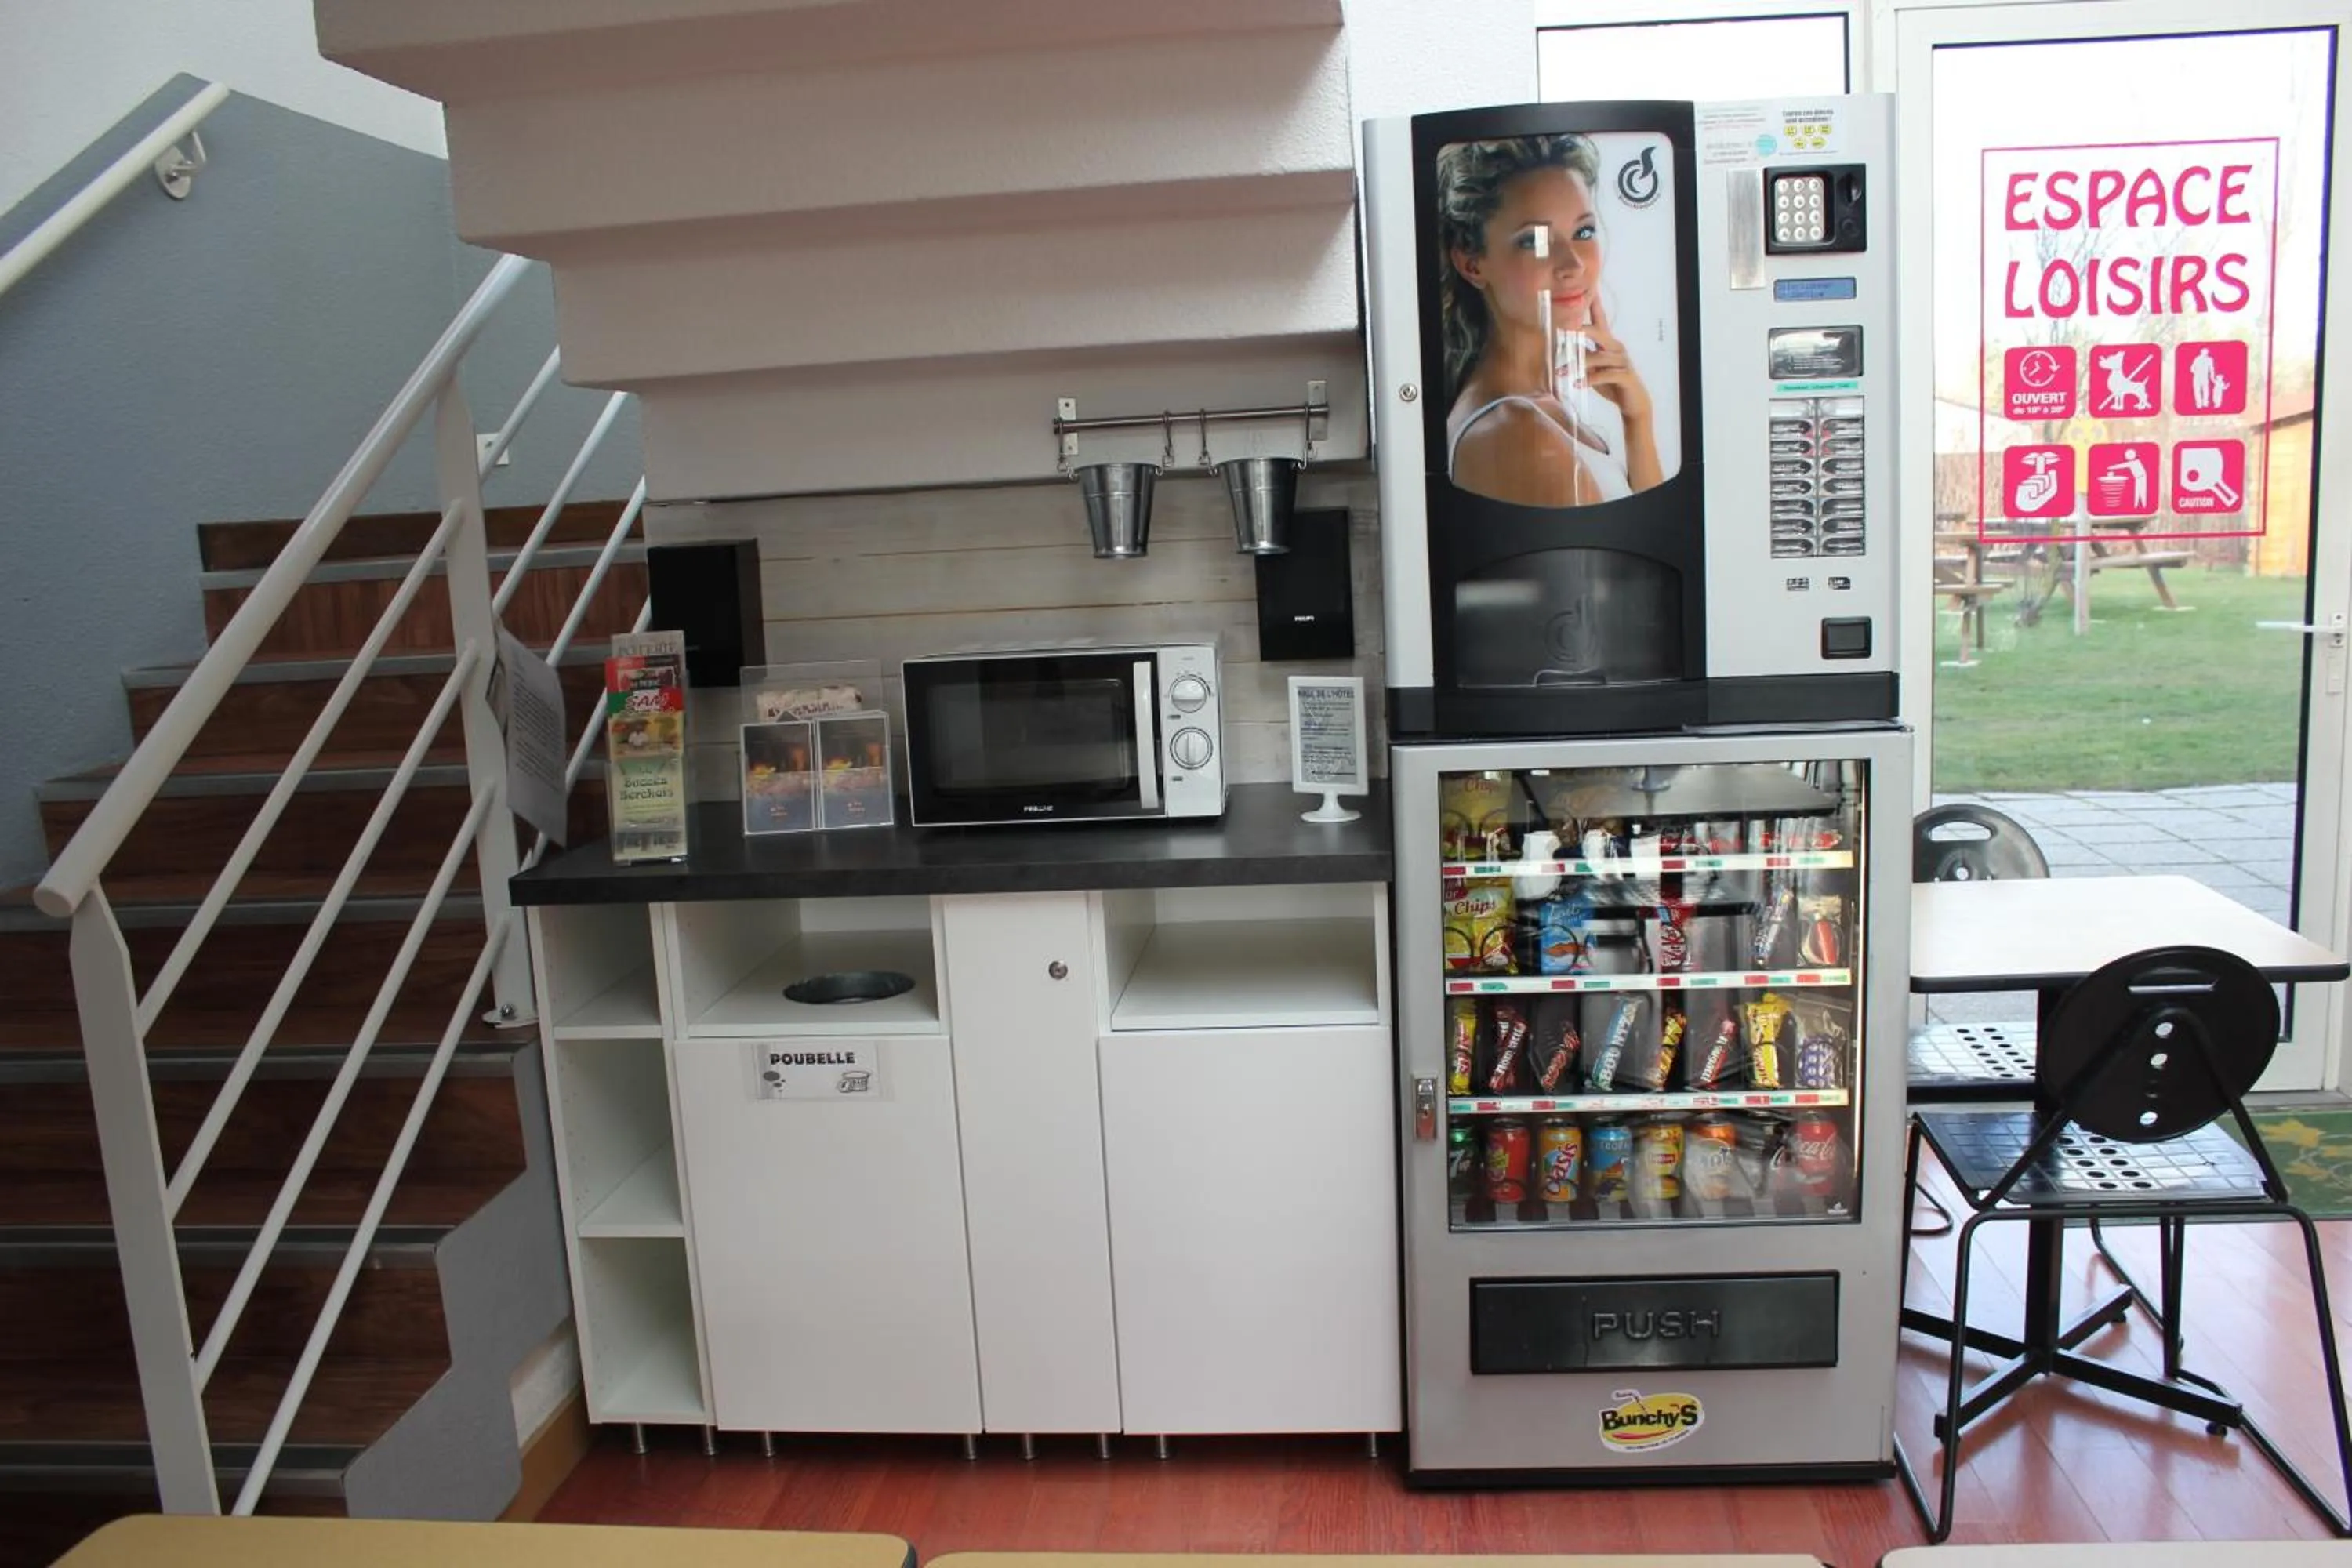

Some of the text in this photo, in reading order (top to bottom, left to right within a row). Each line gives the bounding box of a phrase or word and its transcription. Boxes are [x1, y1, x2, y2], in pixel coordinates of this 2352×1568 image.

[2005, 164, 2252, 231] ESPACE
[2005, 252, 2250, 318] LOISIRS
[2012, 391, 2067, 405] OUVERT
[2178, 496, 2215, 508] CAUTION
[1454, 898, 1497, 917] Chips
[770, 1051, 856, 1065] POUBELLE
[1593, 1309, 1720, 1339] PUSH
